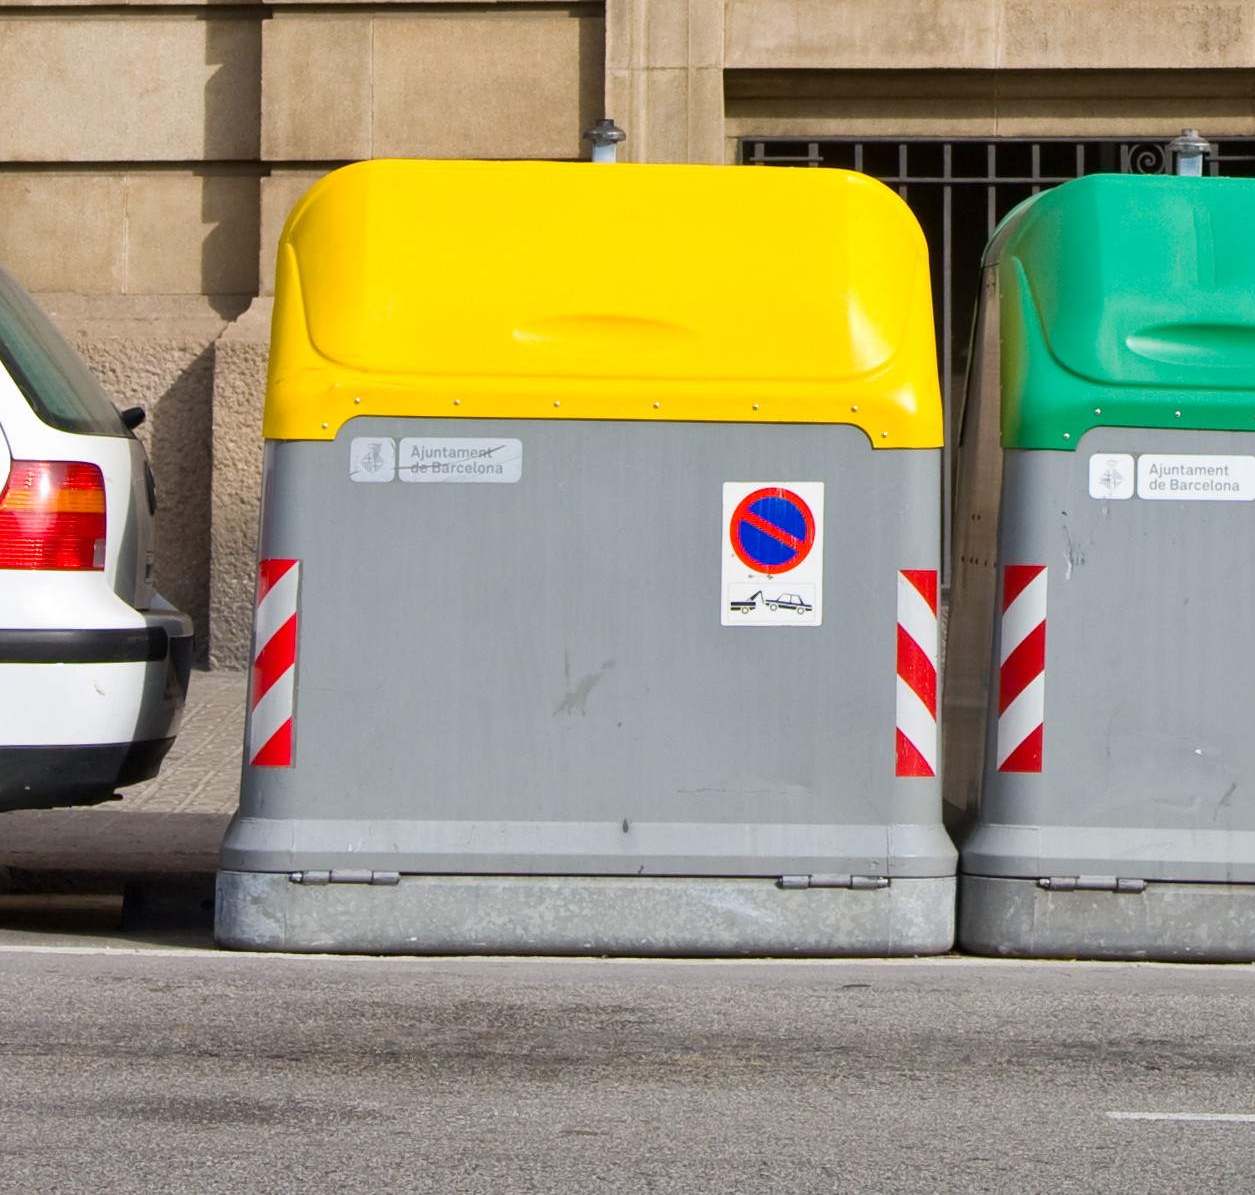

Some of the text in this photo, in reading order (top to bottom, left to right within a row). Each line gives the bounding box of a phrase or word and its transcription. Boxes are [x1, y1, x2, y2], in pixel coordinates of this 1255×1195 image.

[410, 444, 494, 461] Ajuntament
[410, 461, 504, 475] de Barcelona
[1148, 463, 1230, 479] Ajuntament
[1149, 479, 1240, 492] de Barcelona
